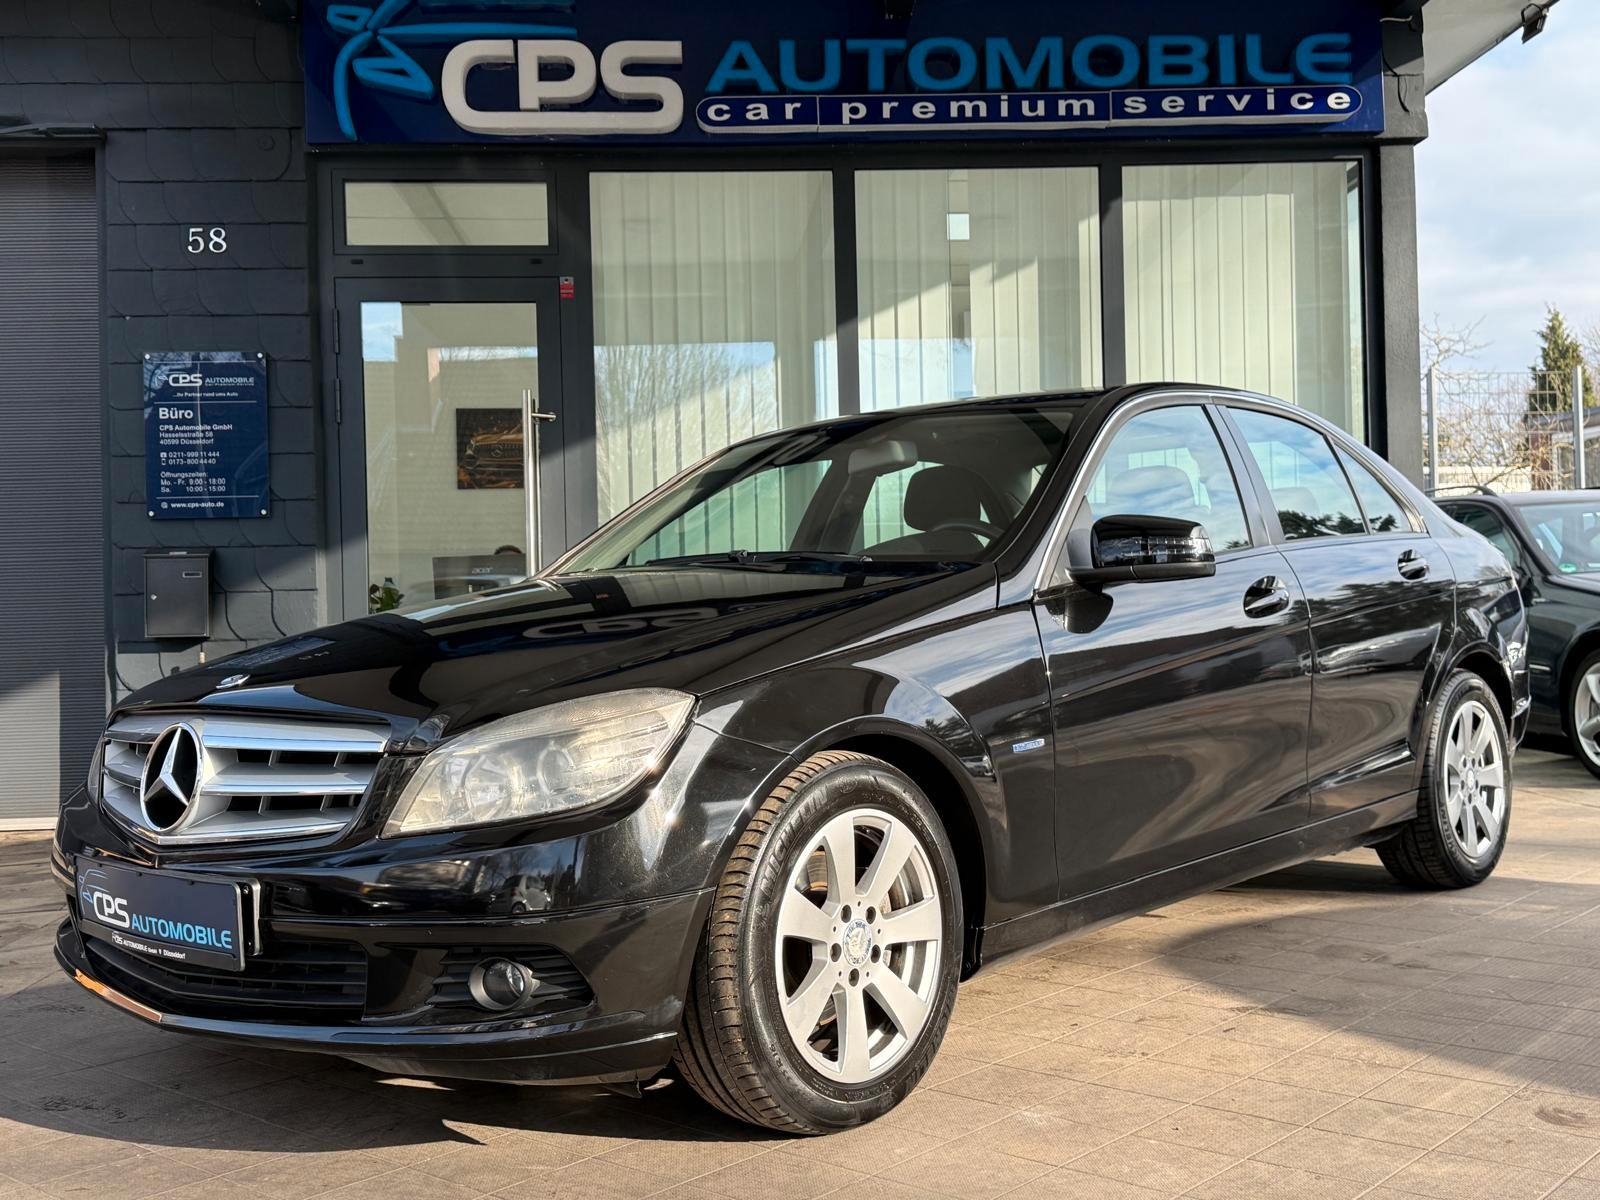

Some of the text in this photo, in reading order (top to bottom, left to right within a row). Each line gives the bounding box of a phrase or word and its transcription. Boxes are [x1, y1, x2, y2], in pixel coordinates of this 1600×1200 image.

[441, 33, 1353, 135] CPS AUTOMOBILE
[707, 89, 1351, 124] car premium service
[187, 227, 227, 253] 58
[168, 374, 203, 387] CPS
[158, 408, 194, 419] Büro
[170, 501, 225, 509] www.cps-auto.de
[471, 566, 494, 575] acer
[760, 784, 828, 898] MICHELIN
[92, 891, 130, 929] CPS
[131, 913, 233, 949] AUTOMOBILE
